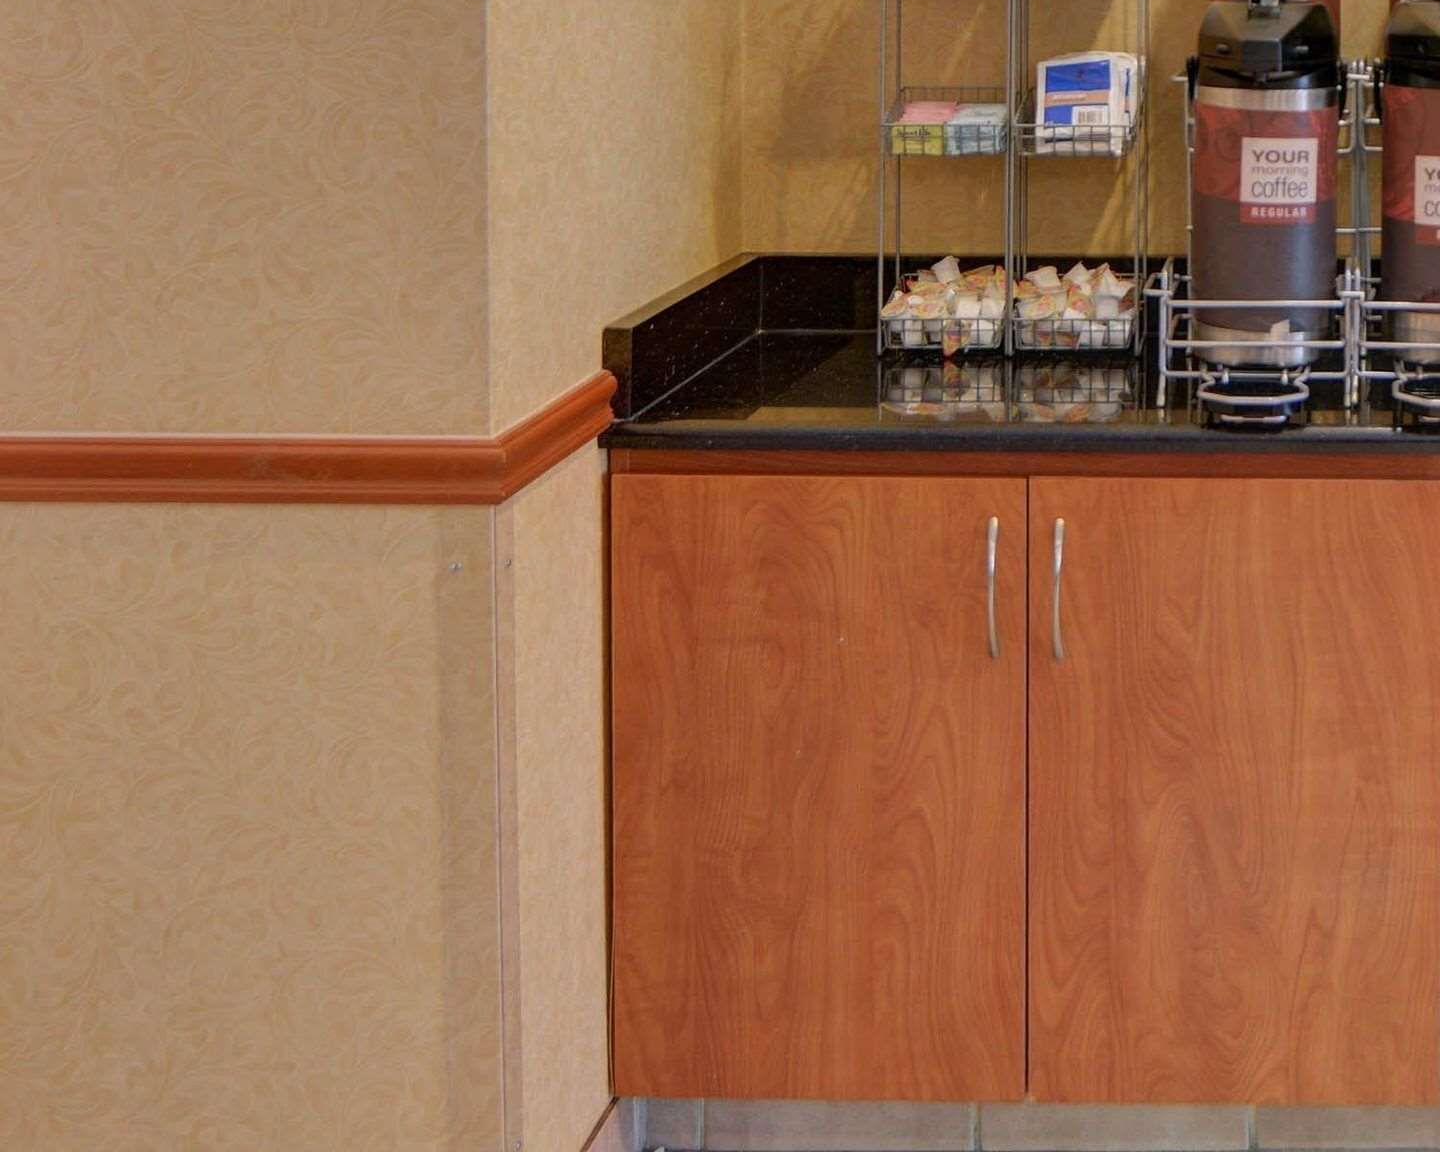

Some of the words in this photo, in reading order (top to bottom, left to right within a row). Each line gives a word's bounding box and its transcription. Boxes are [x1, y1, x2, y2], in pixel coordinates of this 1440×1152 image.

[1251, 150, 1309, 163] YOUR
[1251, 166, 1308, 177] morning
[1251, 176, 1308, 198] coffee
[1250, 206, 1307, 217] REGULAR
